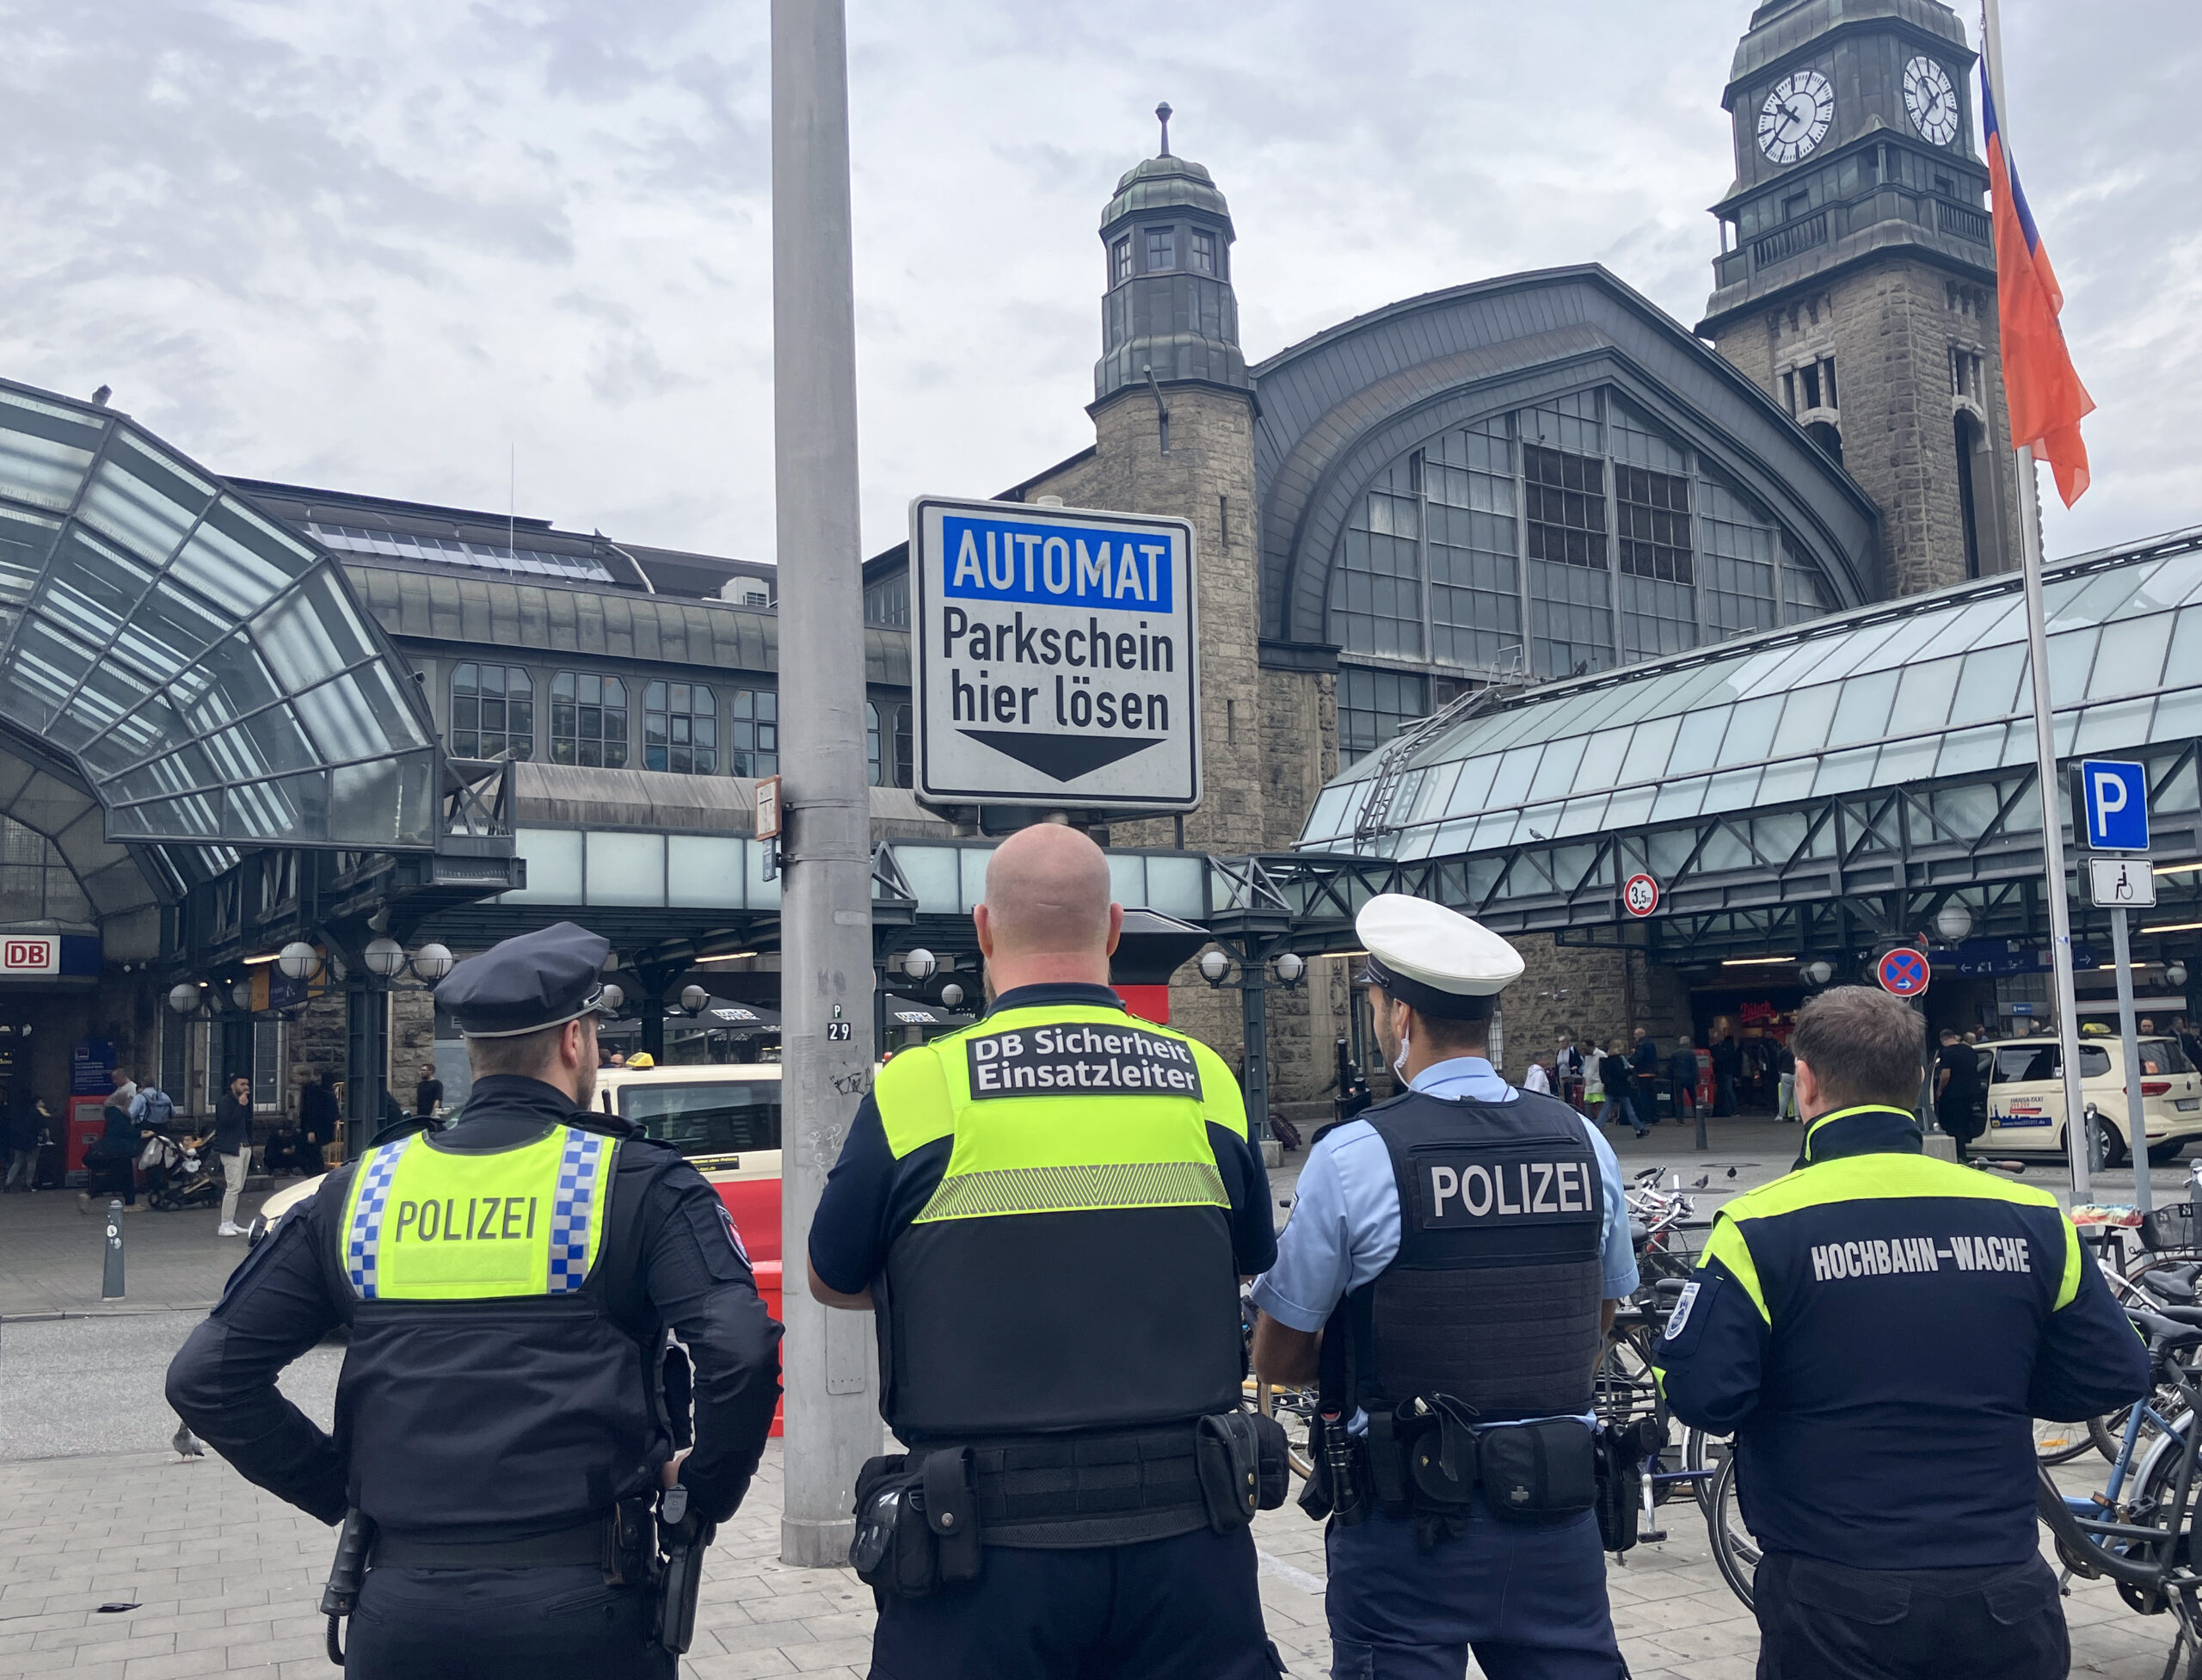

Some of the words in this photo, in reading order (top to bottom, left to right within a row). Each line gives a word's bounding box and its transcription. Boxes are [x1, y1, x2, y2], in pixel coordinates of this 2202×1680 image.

[952, 529, 1166, 601] AUTOMAT
[944, 606, 1173, 672] Parkschein
[951, 669, 1038, 723] hier
[1055, 675, 1169, 730] lösen
[2094, 772, 2127, 837] P
[10, 945, 45, 964] DB
[829, 1023, 850, 1040] 29
[833, 1004, 842, 1018] P
[975, 1034, 1024, 1062] DB
[1034, 1027, 1190, 1064] Sicherheit
[977, 1058, 1196, 1091] Einsatzleiter
[1431, 1162, 1593, 1217] POLIZEI
[396, 1197, 538, 1243] POLIZEI
[1811, 1236, 2031, 1282] HOCHBAHN-WACHE
